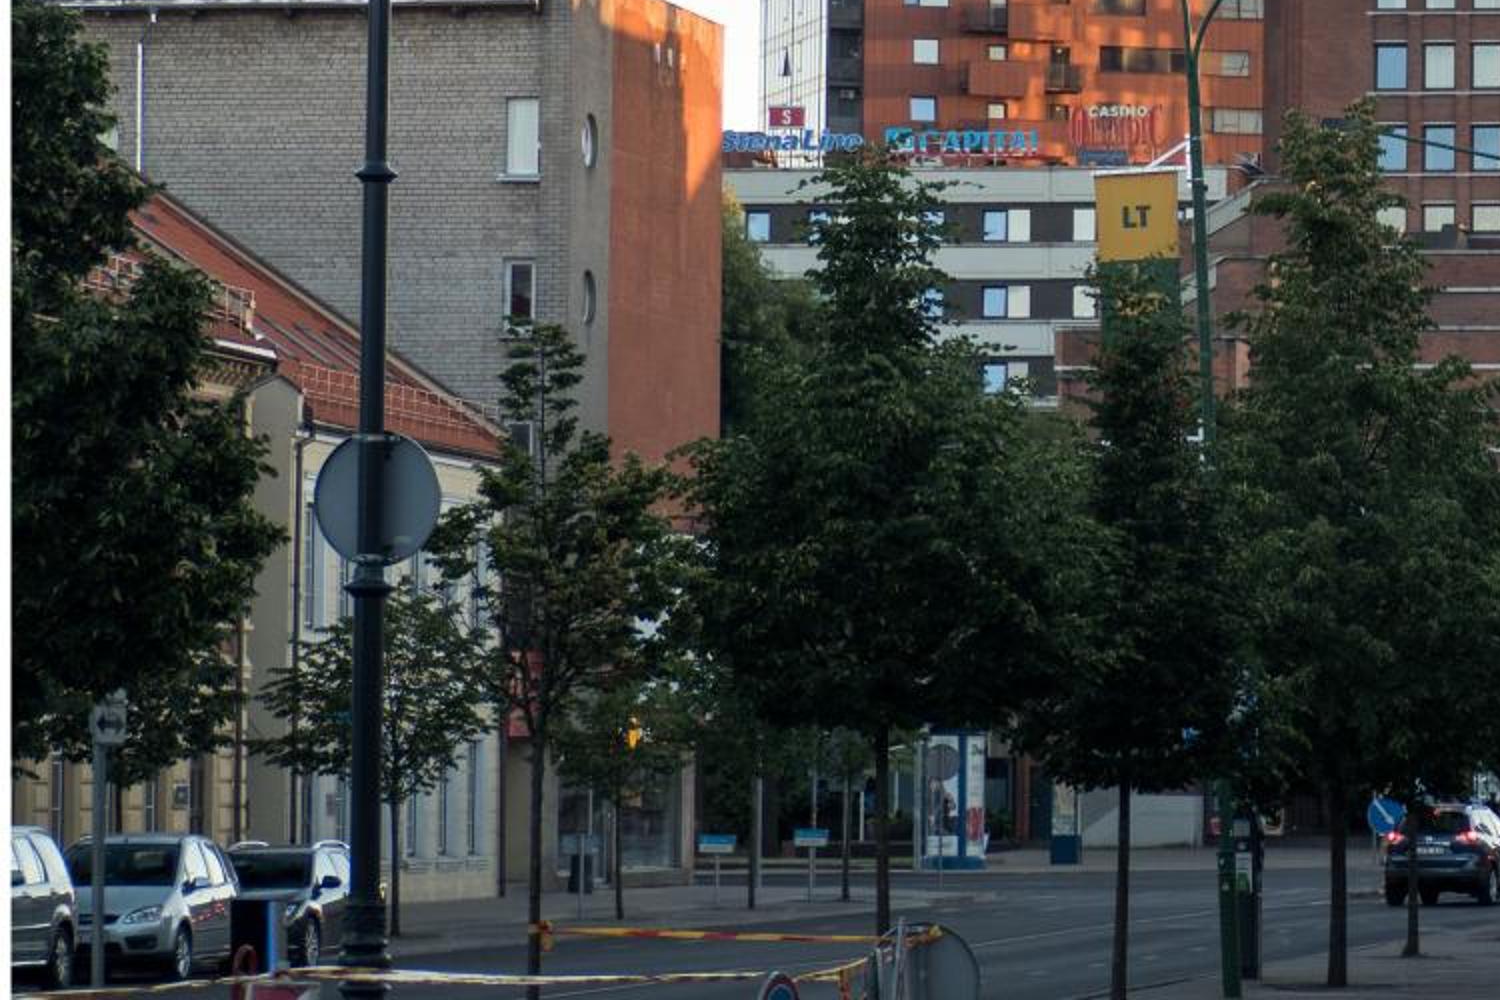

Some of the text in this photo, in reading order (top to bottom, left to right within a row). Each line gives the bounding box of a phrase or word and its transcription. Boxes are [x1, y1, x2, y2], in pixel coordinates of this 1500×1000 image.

[781, 108, 792, 125] S
[1088, 104, 1148, 118] CASINO
[1121, 205, 1152, 229] LT
